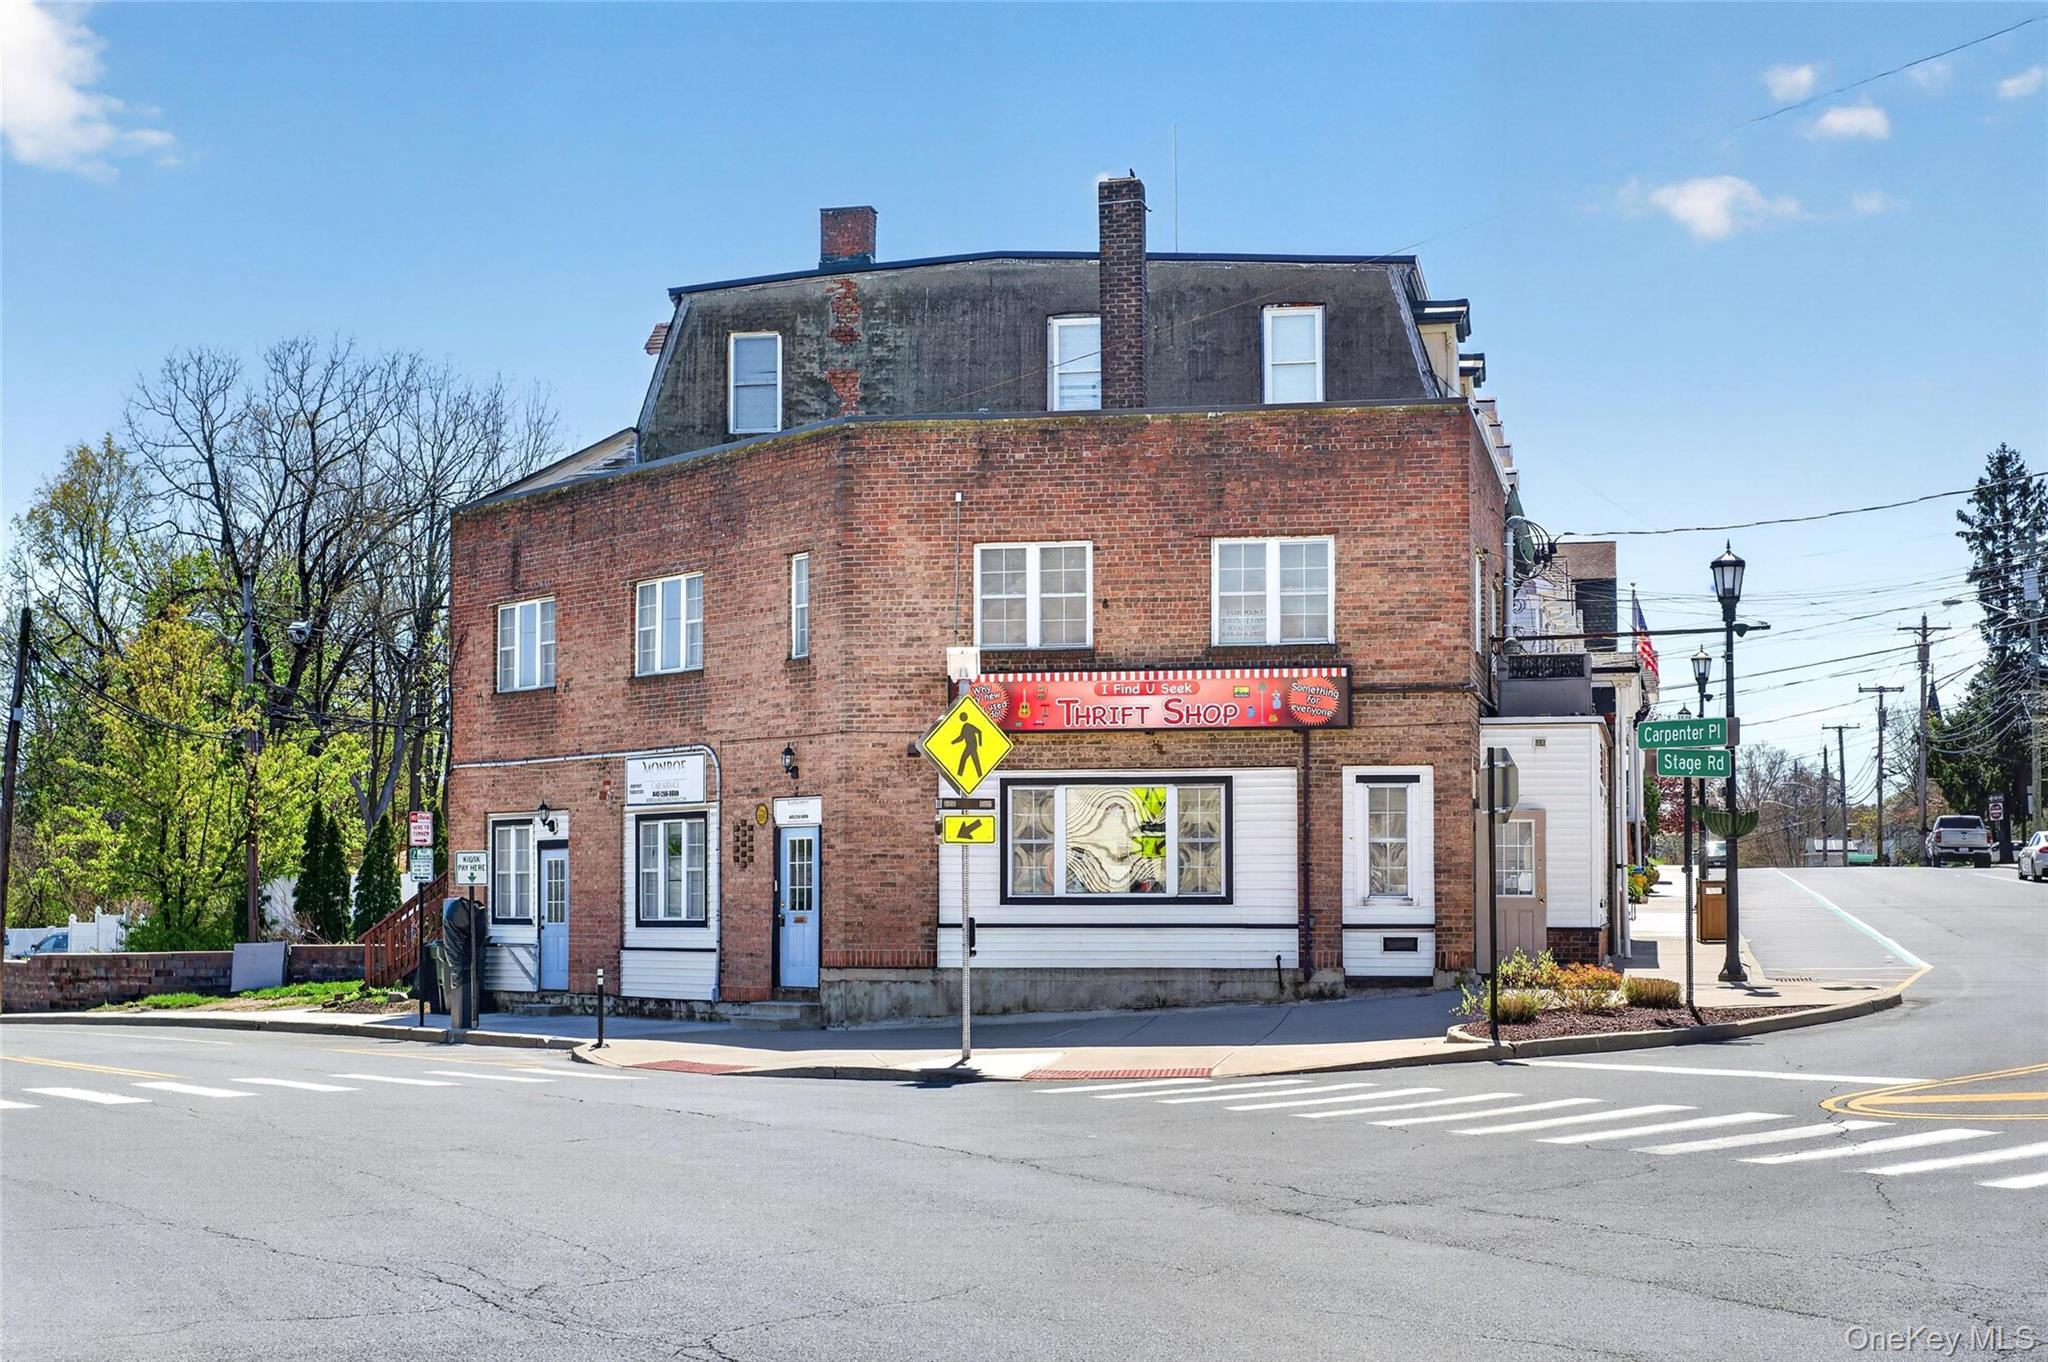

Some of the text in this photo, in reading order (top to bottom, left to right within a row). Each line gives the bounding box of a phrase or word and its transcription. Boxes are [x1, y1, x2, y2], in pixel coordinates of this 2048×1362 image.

[1101, 682, 1193, 695] I Find U Seek
[1291, 682, 1340, 699] Something
[1056, 697, 1240, 726] THRIFT SHOP
[1291, 704, 1333, 717] everyone
[1644, 724, 1721, 744] Carpenter Pl
[642, 760, 687, 775] MONROE
[1664, 753, 1724, 775] Stage Rd
[463, 855, 481, 864] KIOSK
[458, 864, 486, 872] PAY HERE
